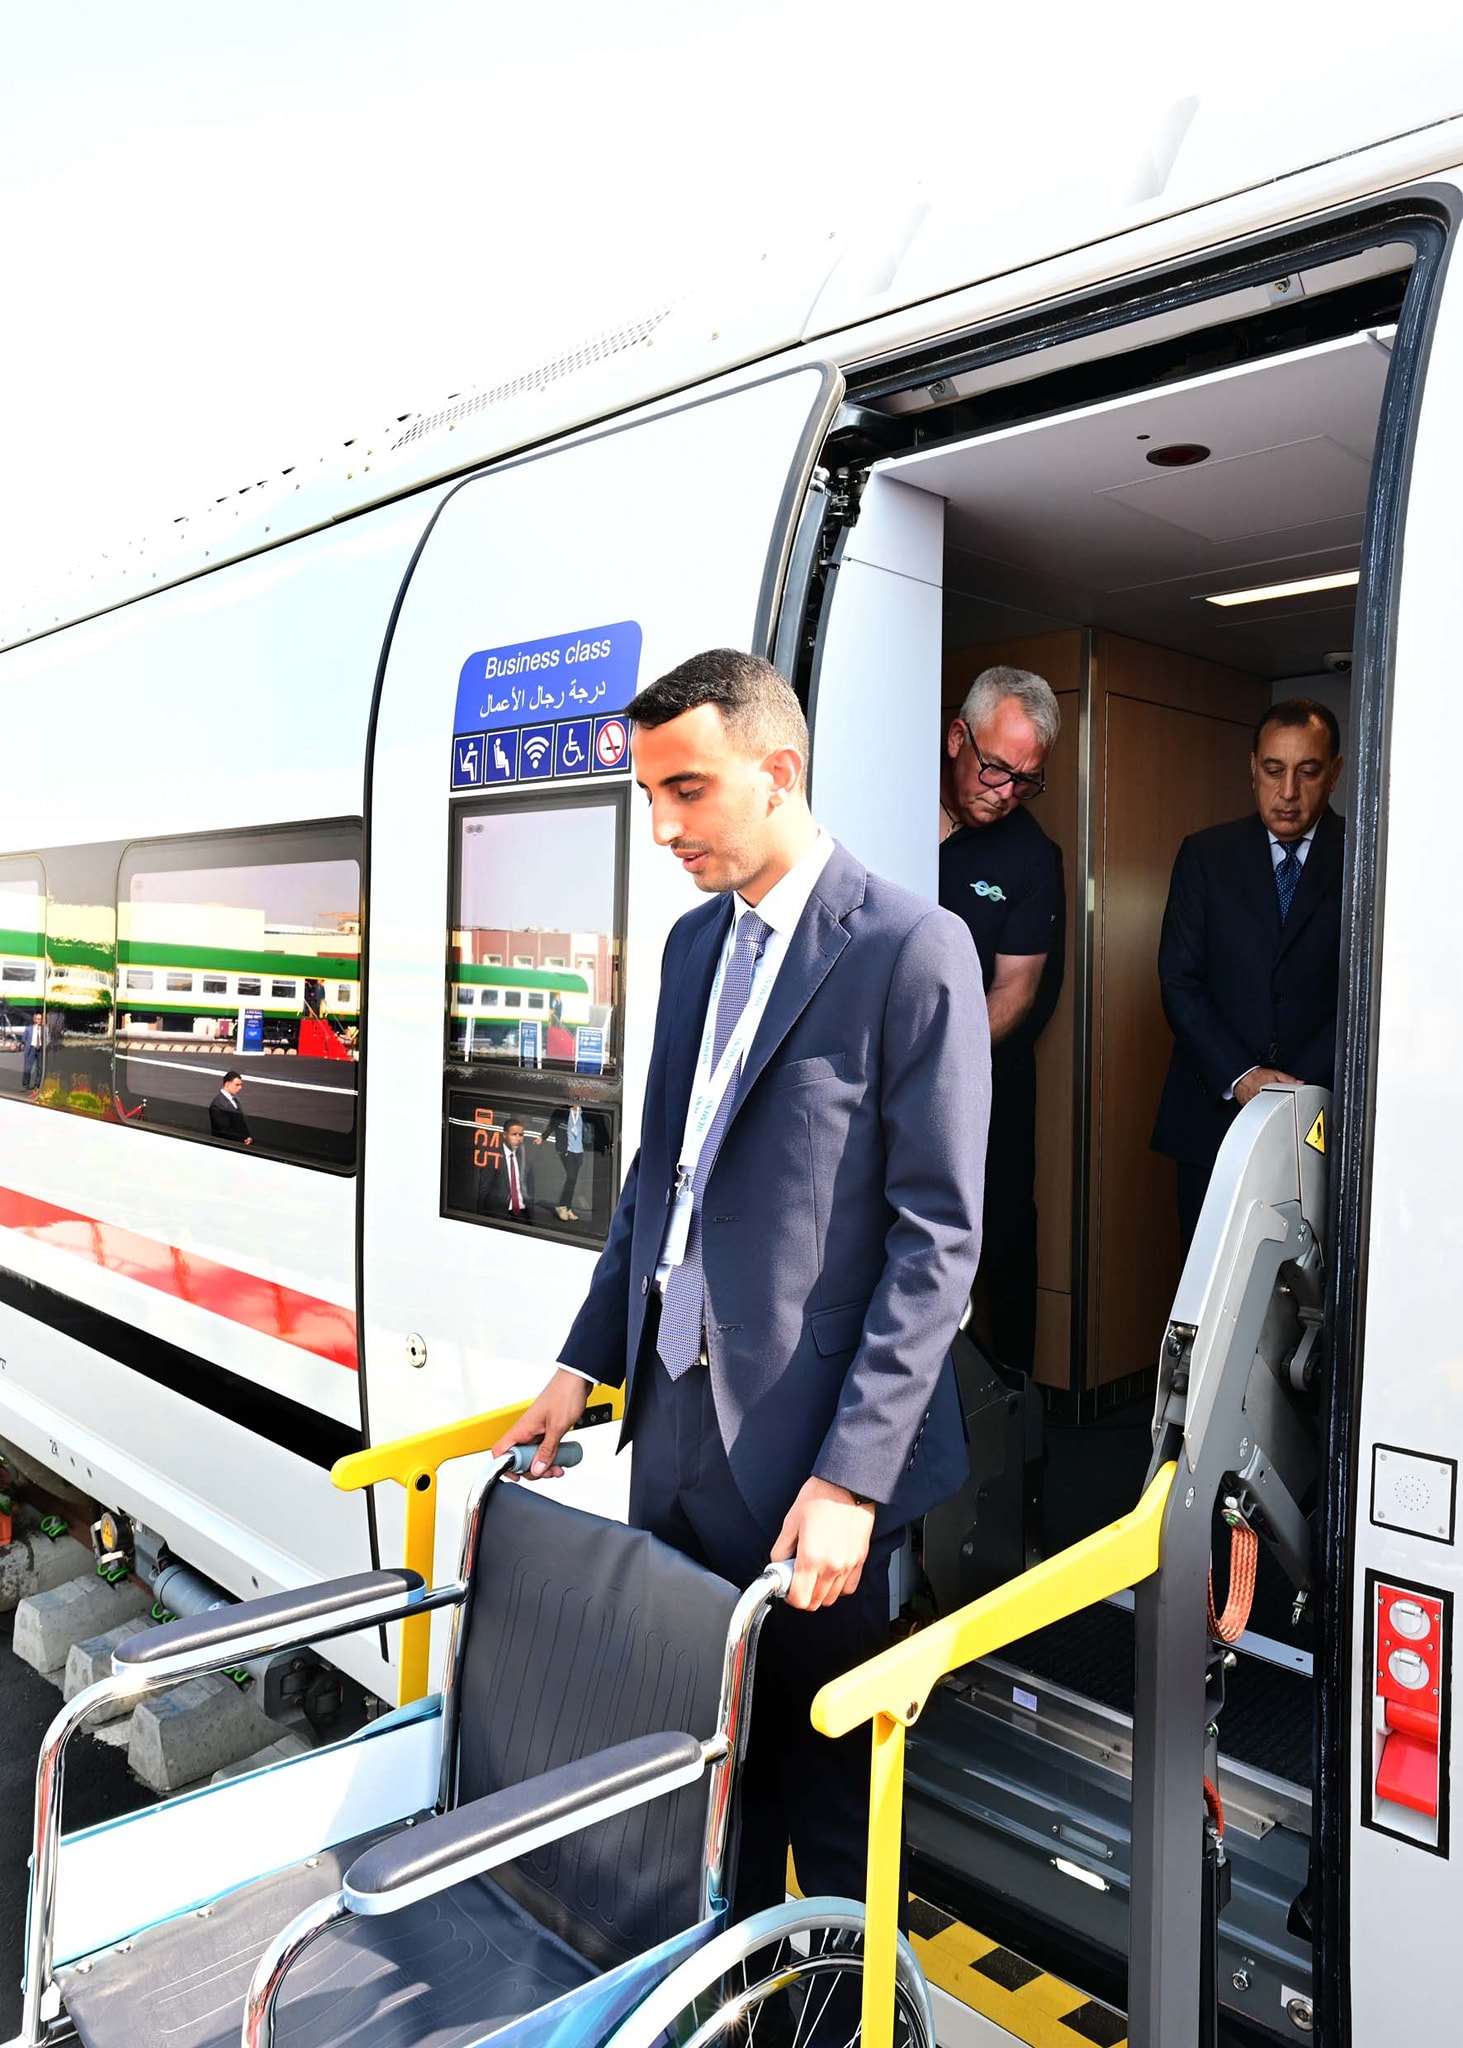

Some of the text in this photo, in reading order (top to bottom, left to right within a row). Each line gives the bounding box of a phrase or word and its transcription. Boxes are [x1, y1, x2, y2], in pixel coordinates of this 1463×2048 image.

[484, 639, 611, 680] Business class
[479, 678, 606, 718] درجة رجال الأعمال
